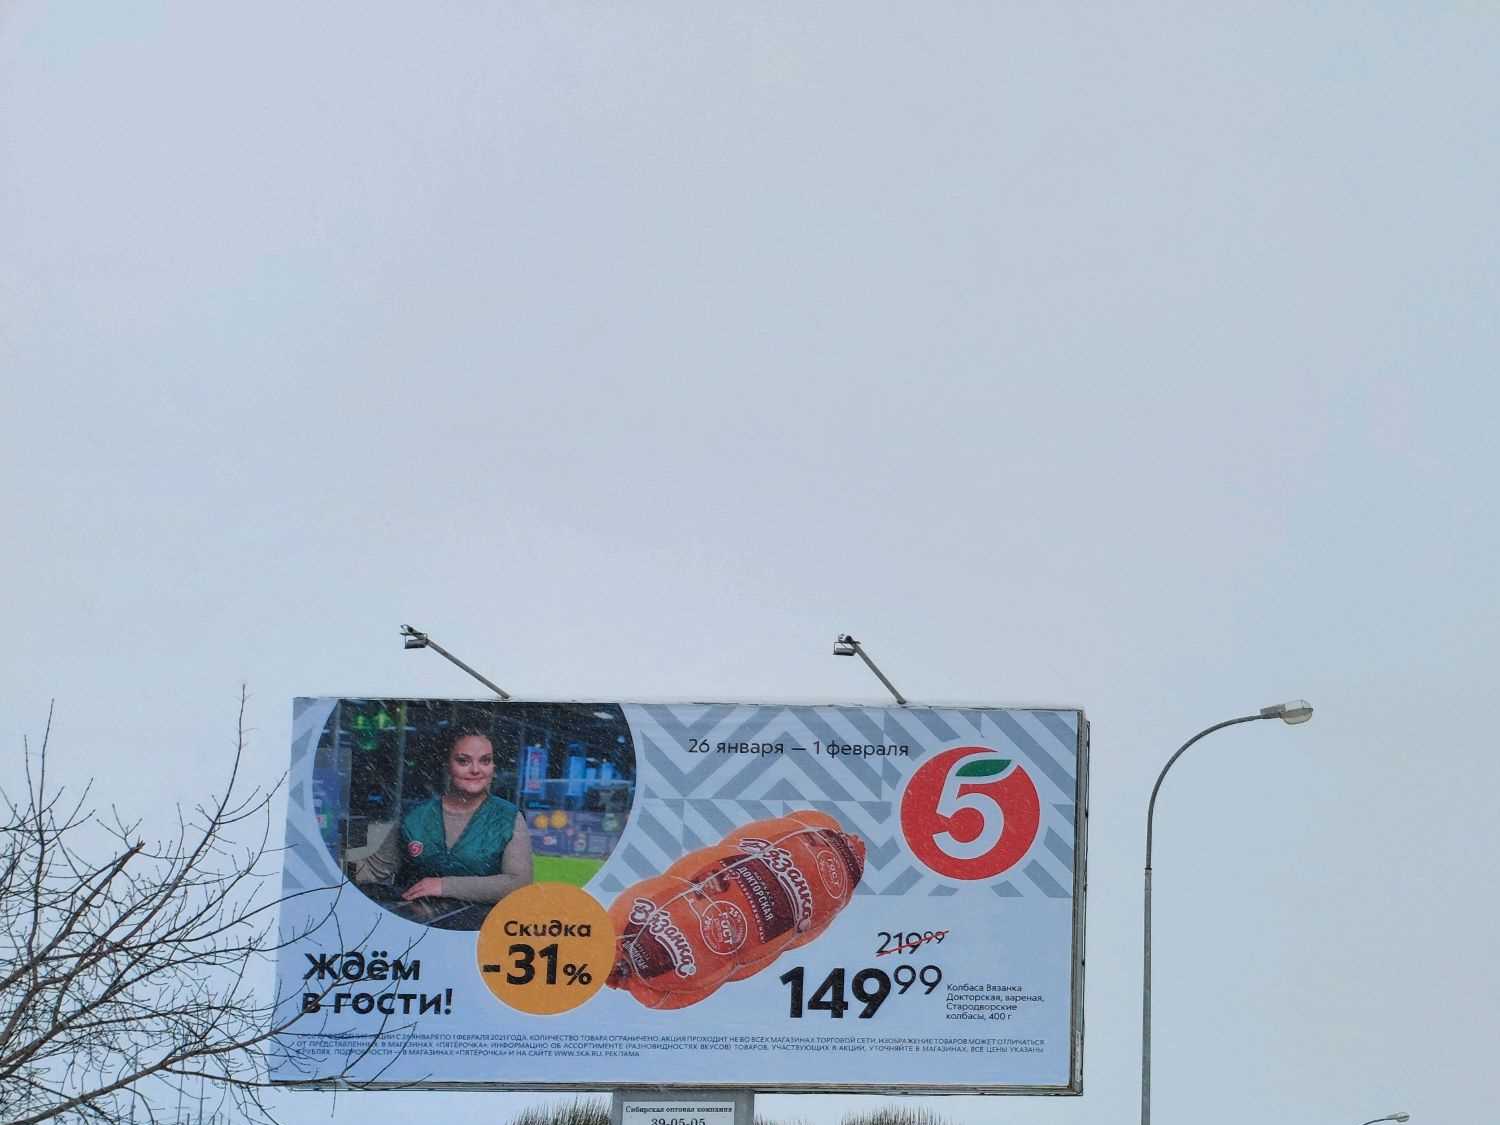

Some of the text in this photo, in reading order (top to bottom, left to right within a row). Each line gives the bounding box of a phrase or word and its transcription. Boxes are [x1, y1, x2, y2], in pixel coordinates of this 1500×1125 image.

[687, 738, 710, 754] 26
[716, 742, 784, 758] января
[812, 741, 820, 755] 1
[826, 740, 909, 759] февраля
[932, 752, 1019, 861] 5
[739, 866, 774, 921] ДОКТОРСКАЯ
[504, 919, 592, 938] Скидка
[629, 898, 696, 978] Вязанка
[303, 951, 421, 981] Ждём
[947, 983, 1022, 992] Колбаса Вязанка
[301, 988, 453, 1015] в гости!
[946, 993, 1003, 1003] Докторская,
[946, 1003, 1018, 1012] Стародворские
[946, 1012, 987, 1021] колбасы,
[988, 1012, 1006, 1020] 400
[625, 1105, 664, 1114] Сибирская
